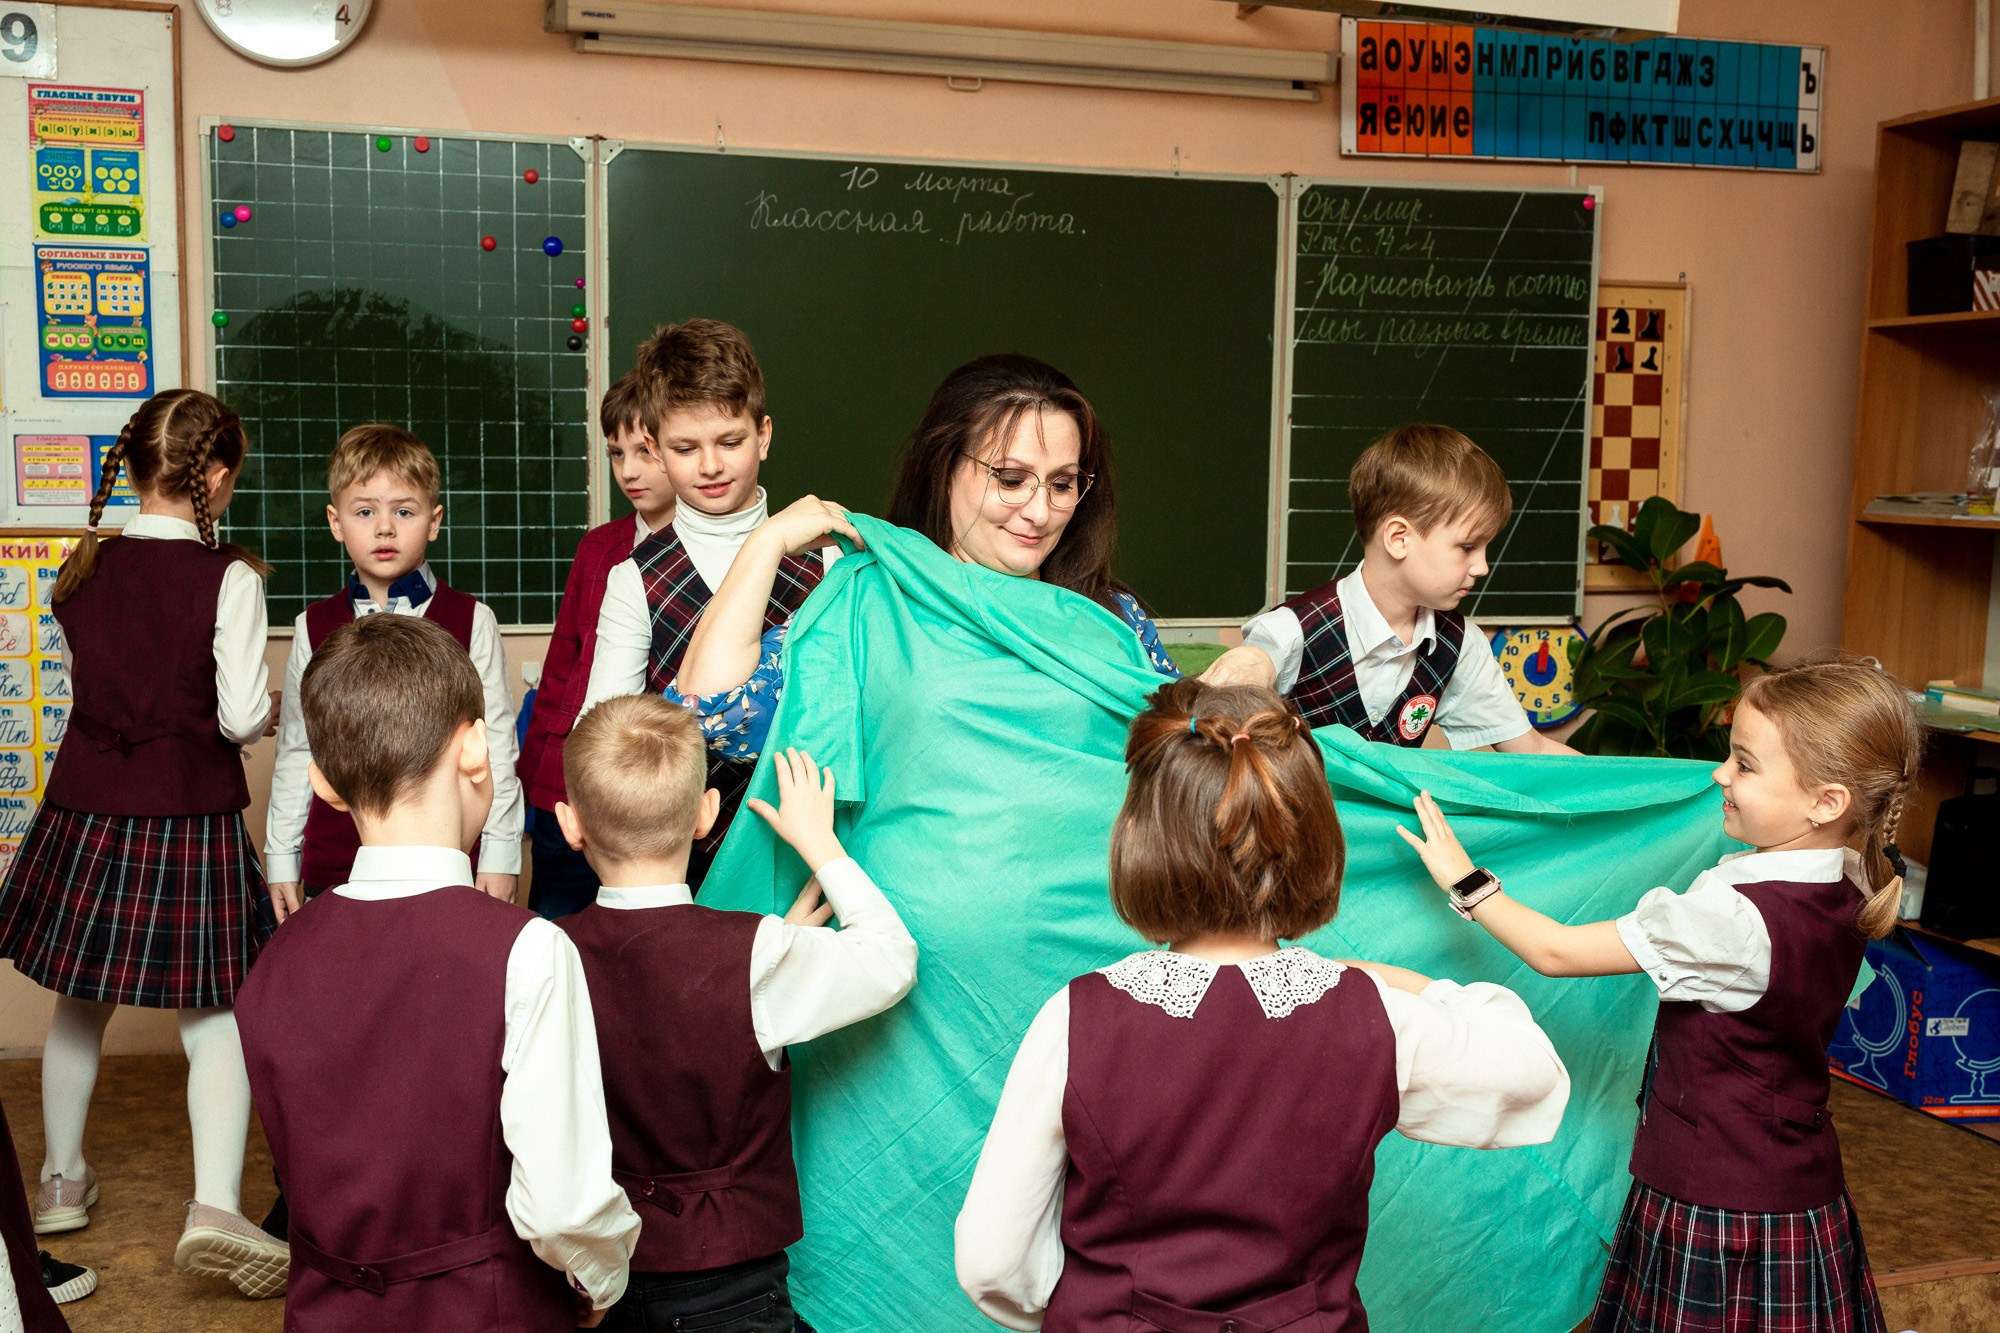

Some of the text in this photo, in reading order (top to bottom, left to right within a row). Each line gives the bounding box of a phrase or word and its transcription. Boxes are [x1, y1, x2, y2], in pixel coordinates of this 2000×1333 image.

[336, 4, 351, 25] 4
[0, 12, 38, 63] 9
[37, 90, 135, 102] ГЛАСНЫЕ ЗВУКИ
[840, 166, 878, 191] 10
[745, 190, 931, 233] Классная
[39, 250, 144, 260] СОГЛАСНЫЕ ЗВУКИ
[1519, 634, 1562, 646] 11 1
[1536, 630, 1549, 640] 12
[1505, 646, 1519, 656] 10
[1503, 662, 1511, 672] 9
[1563, 682, 1571, 692] 4
[1518, 692, 1560, 704] 7 5
[1534, 698, 1542, 708] 6
[43, 706, 63, 718] Рр
[1904, 991, 1923, 1079] Глобус
